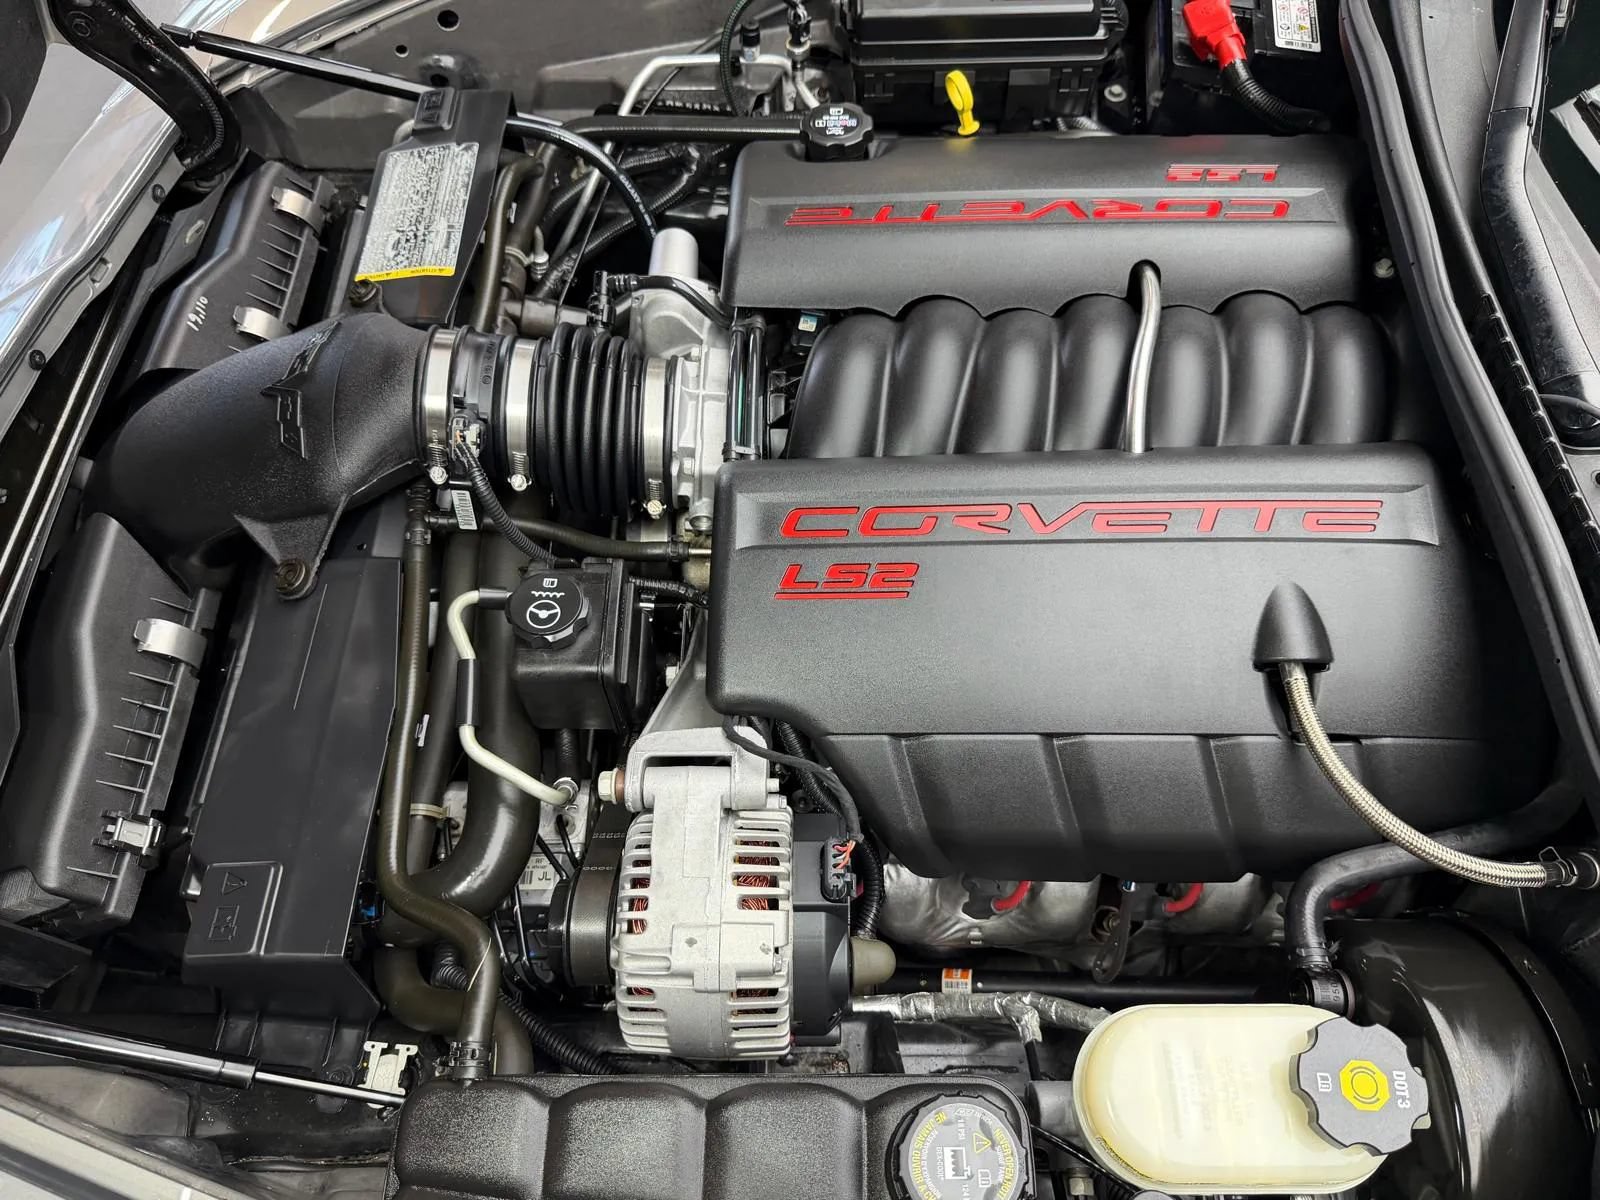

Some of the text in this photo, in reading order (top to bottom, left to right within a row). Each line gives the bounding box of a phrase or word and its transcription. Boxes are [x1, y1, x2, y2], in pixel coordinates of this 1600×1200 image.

[619, 175, 641, 203] GALAXY
[784, 197, 1290, 227] CORVETTE
[779, 499, 1383, 538] CORVETTE
[778, 562, 919, 590] LS2
[538, 871, 551, 881] JL
[934, 1111, 947, 1125] NE
[914, 1119, 934, 1149] JAMAIS
[911, 1151, 924, 1184] OUVRIR
[993, 1127, 1012, 1155] NEVER
[1004, 1156, 1014, 1180] OPEN
